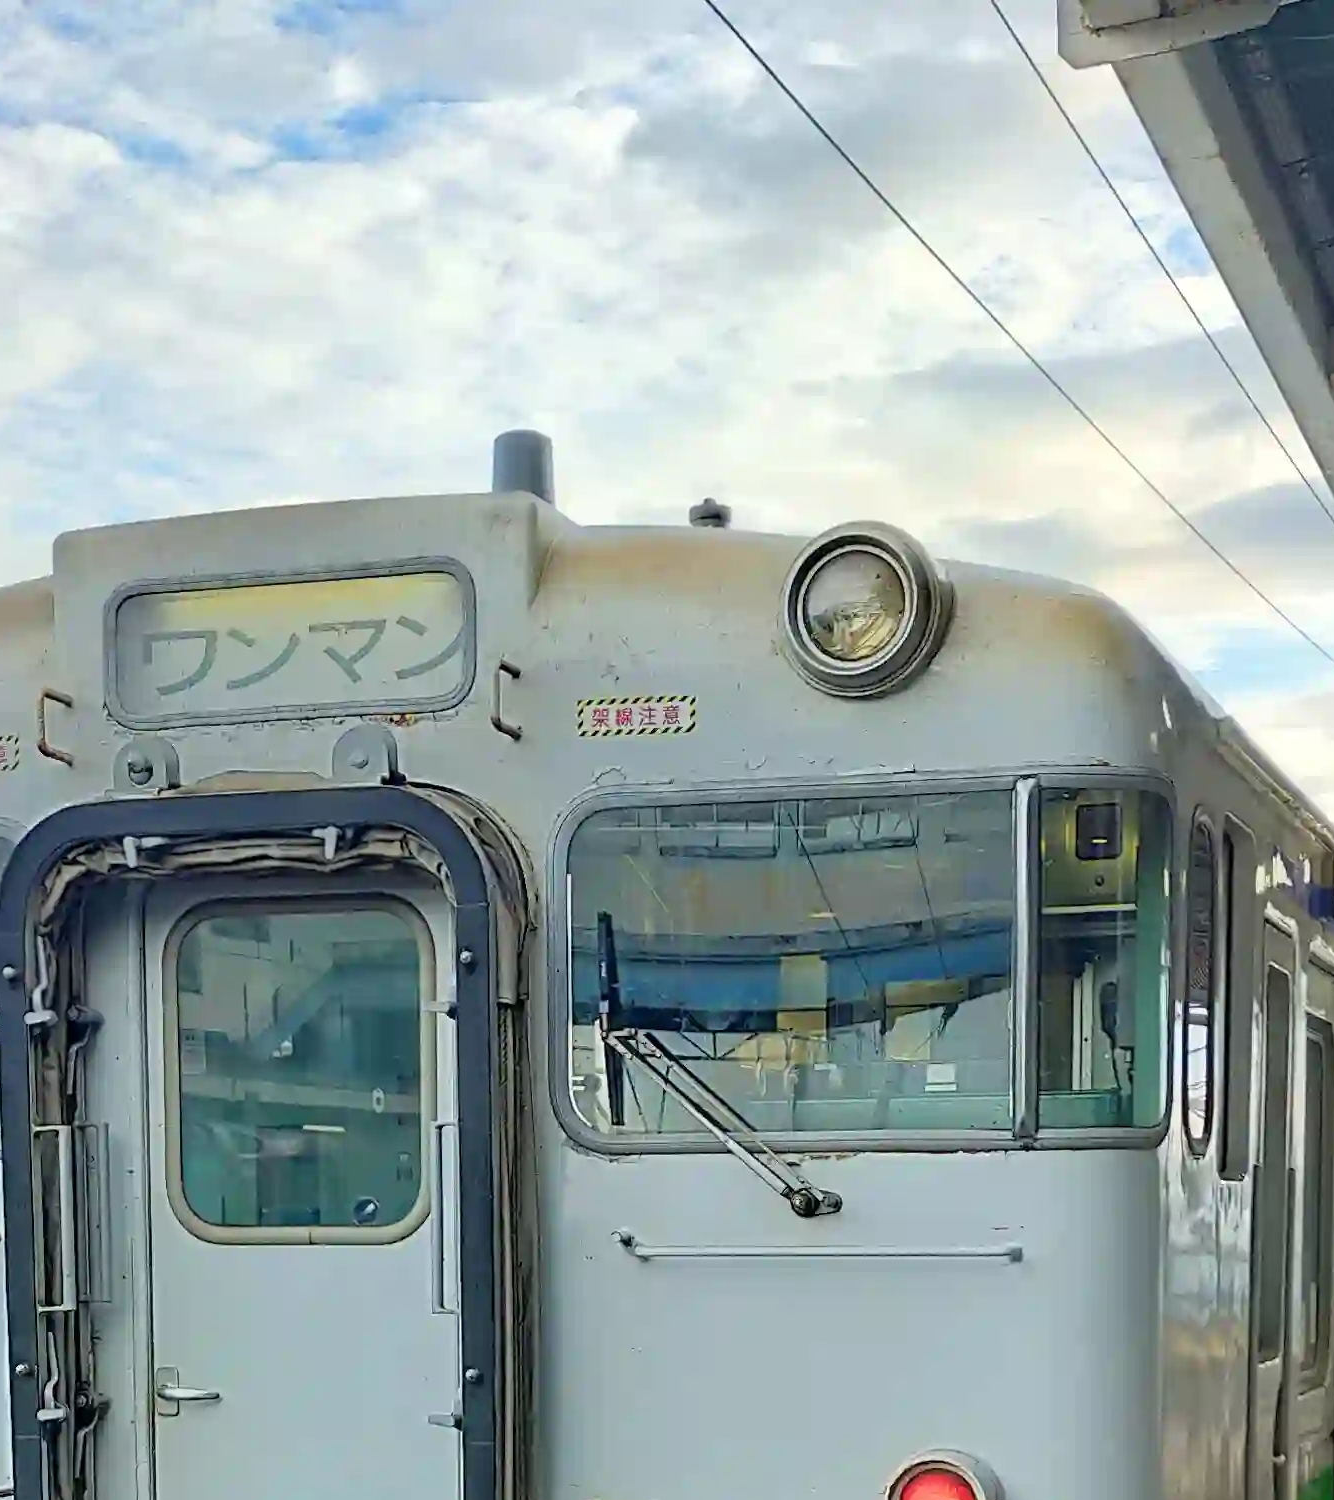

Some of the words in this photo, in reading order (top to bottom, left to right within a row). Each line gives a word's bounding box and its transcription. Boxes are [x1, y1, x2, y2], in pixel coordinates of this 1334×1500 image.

[142, 615, 464, 696] ワンマン
[592, 704, 681, 728] 架線注意
